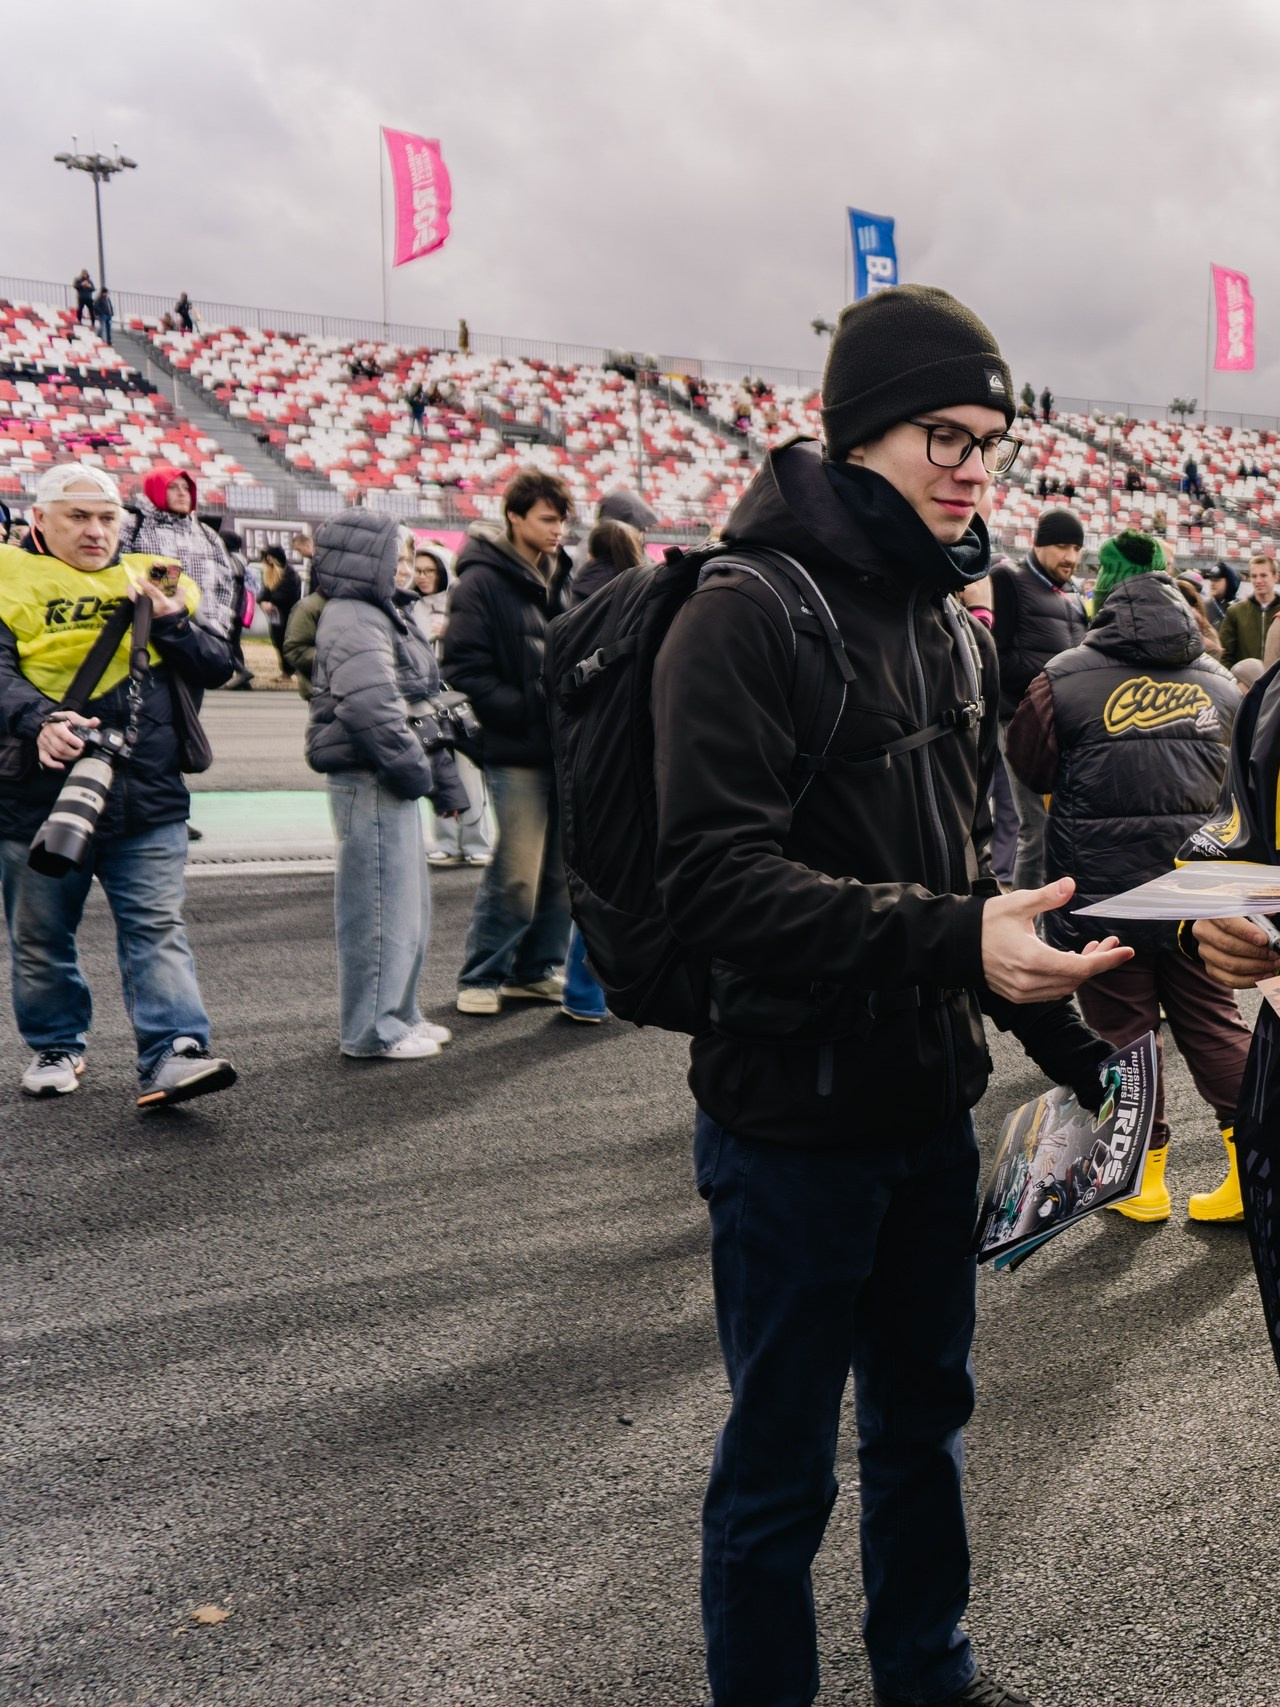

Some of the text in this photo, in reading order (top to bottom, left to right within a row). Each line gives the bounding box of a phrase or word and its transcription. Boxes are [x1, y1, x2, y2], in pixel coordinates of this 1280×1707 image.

[1104, 676, 1213, 735] GOCHA
[1120, 1060, 1128, 1098] SERIES
[1126, 1067, 1134, 1099] DRIFT
[1131, 1051, 1140, 1100] RUSSIAN
[1101, 1107, 1138, 1185] RDS
